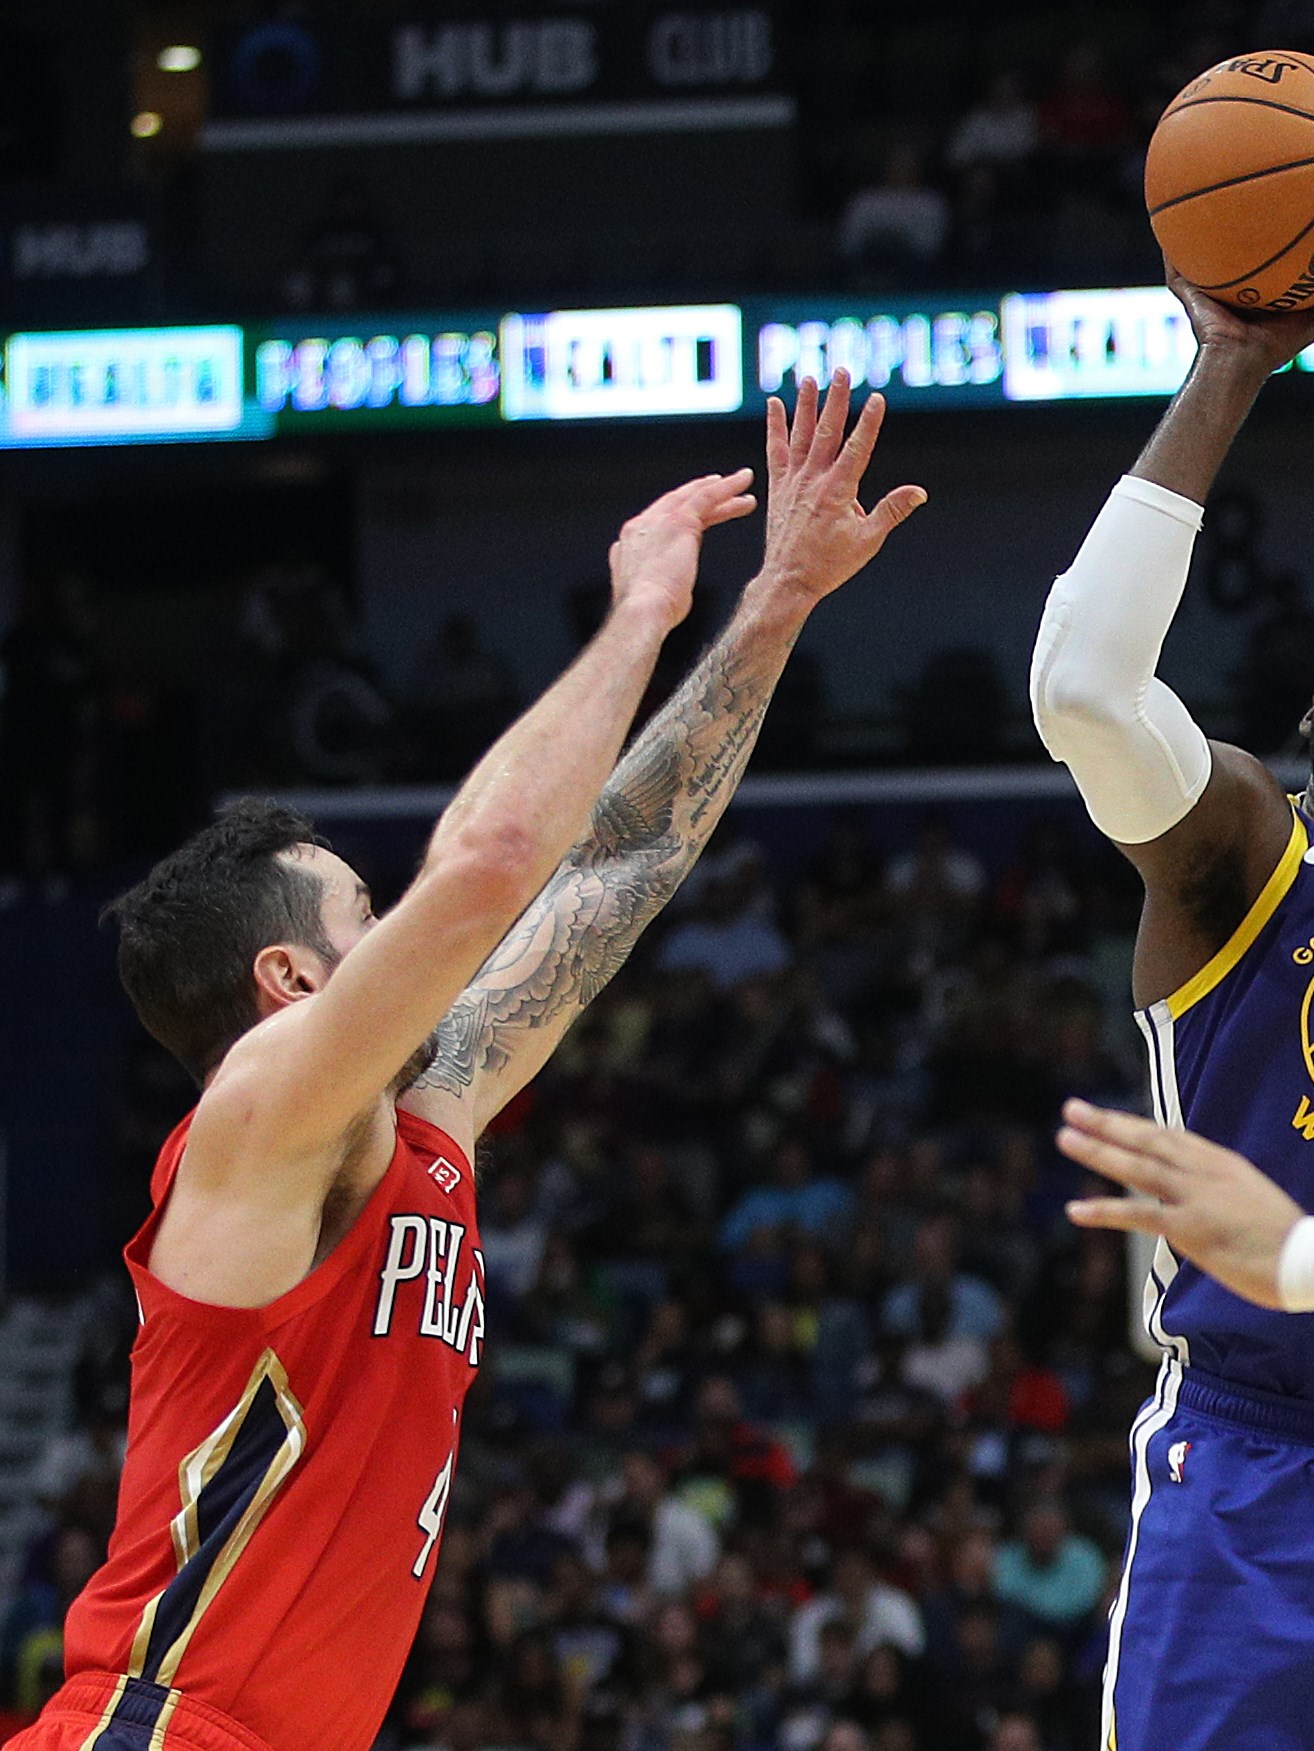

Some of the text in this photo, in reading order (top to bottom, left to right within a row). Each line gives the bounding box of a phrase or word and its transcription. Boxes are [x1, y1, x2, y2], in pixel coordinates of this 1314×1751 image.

[394, 10, 773, 98] HUB CLUB
[256, 331, 500, 412] PEOPLES
